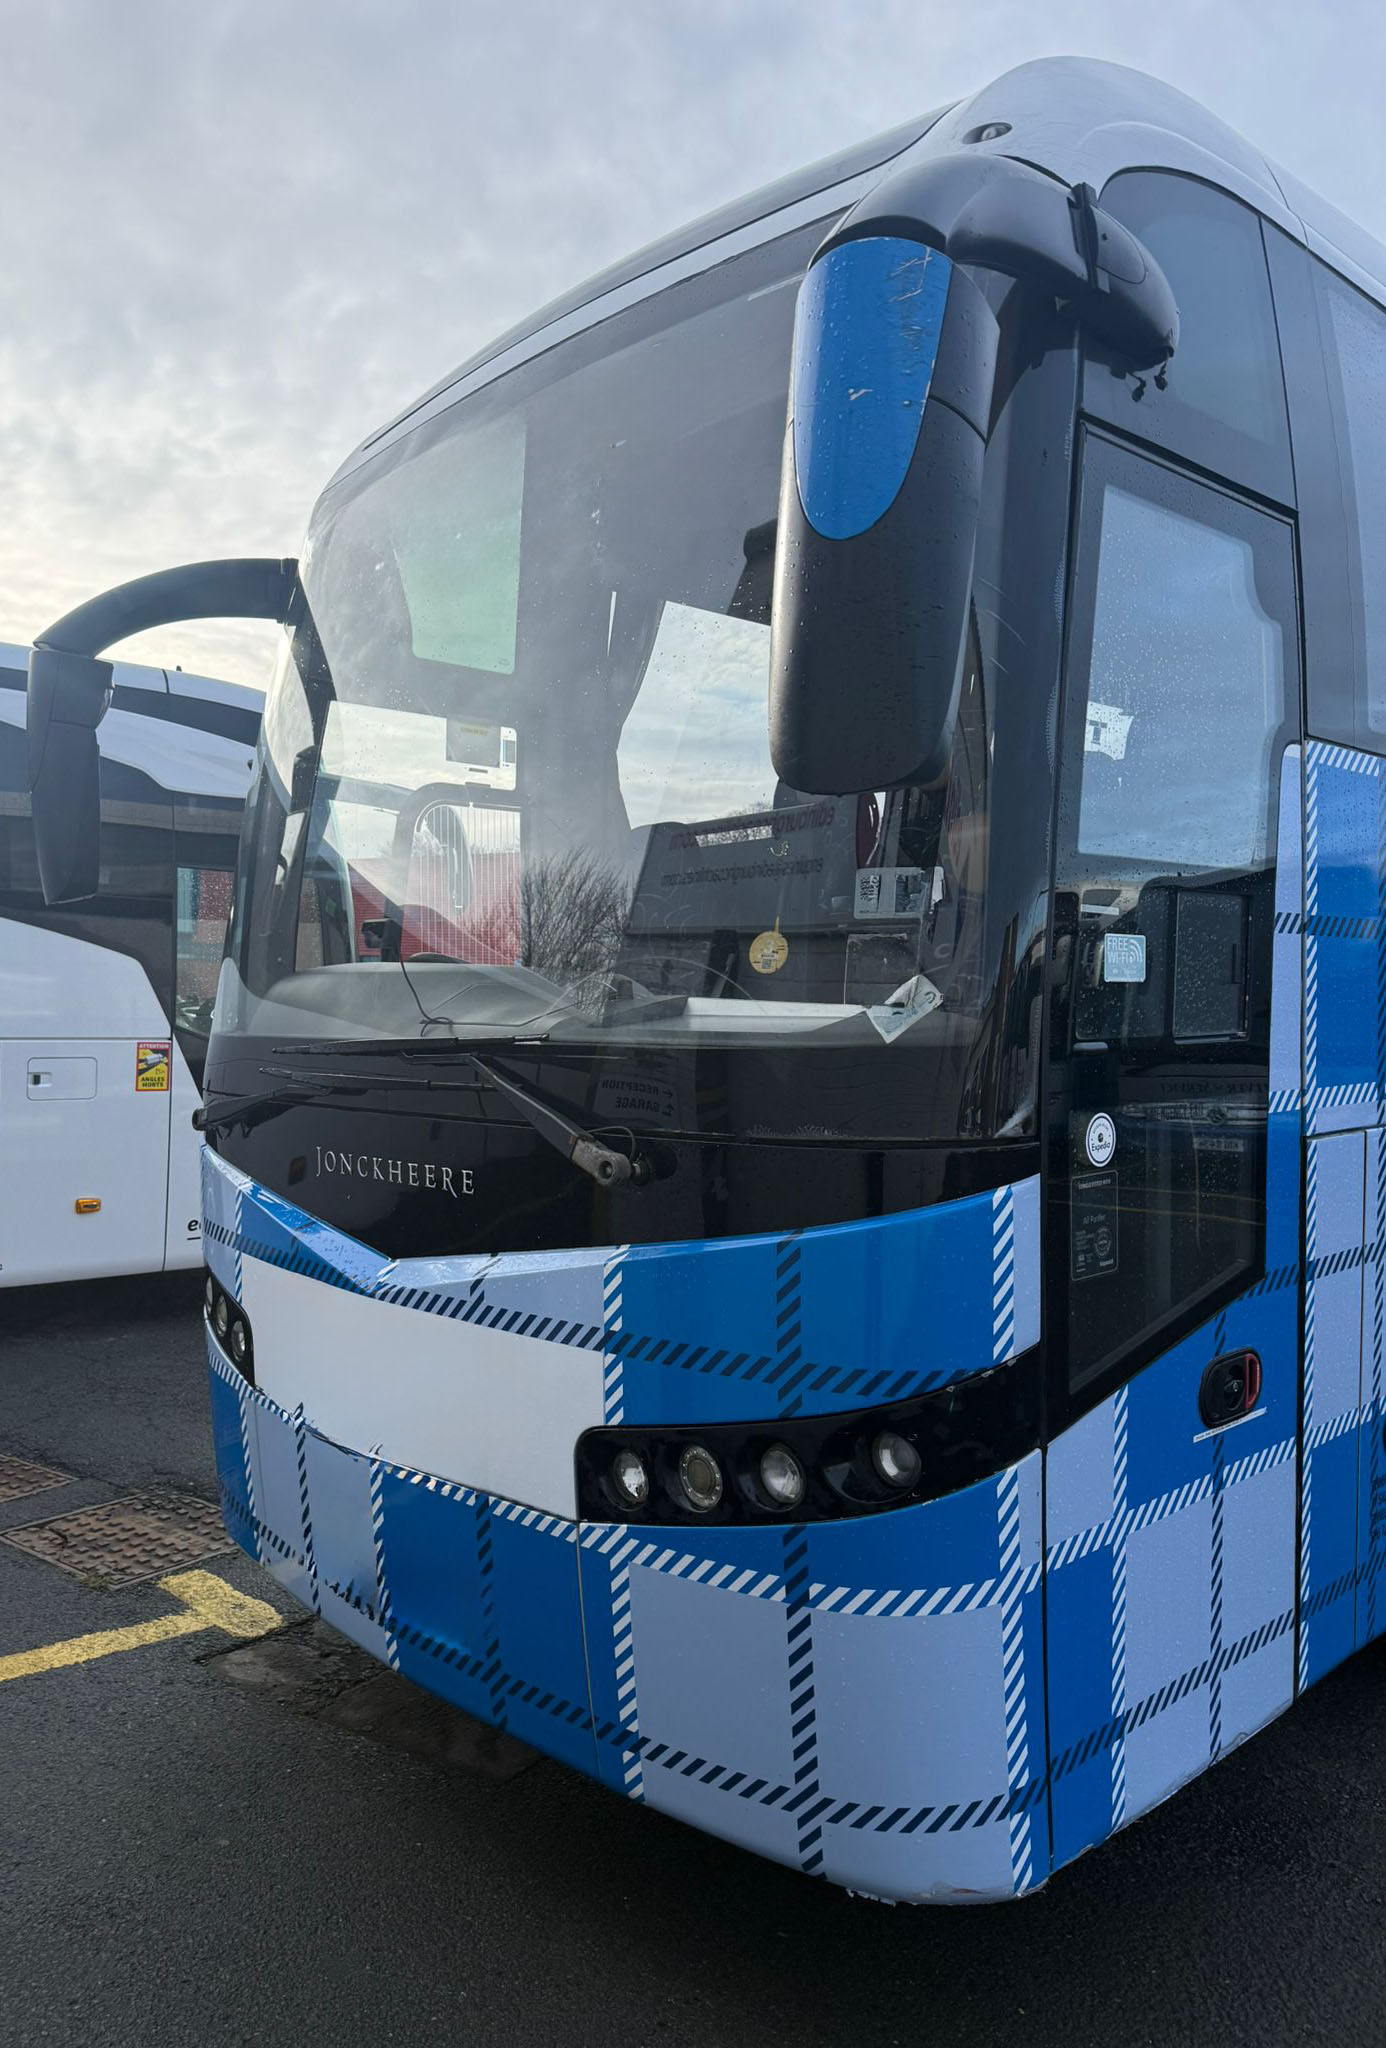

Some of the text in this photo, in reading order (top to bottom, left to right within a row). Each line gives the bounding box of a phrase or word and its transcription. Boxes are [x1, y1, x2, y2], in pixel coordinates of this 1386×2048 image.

[1107, 937, 1128, 951] FREE
[1091, 1141, 1111, 1153] Expedia
[315, 1145, 475, 1198] JONCKHEERE
